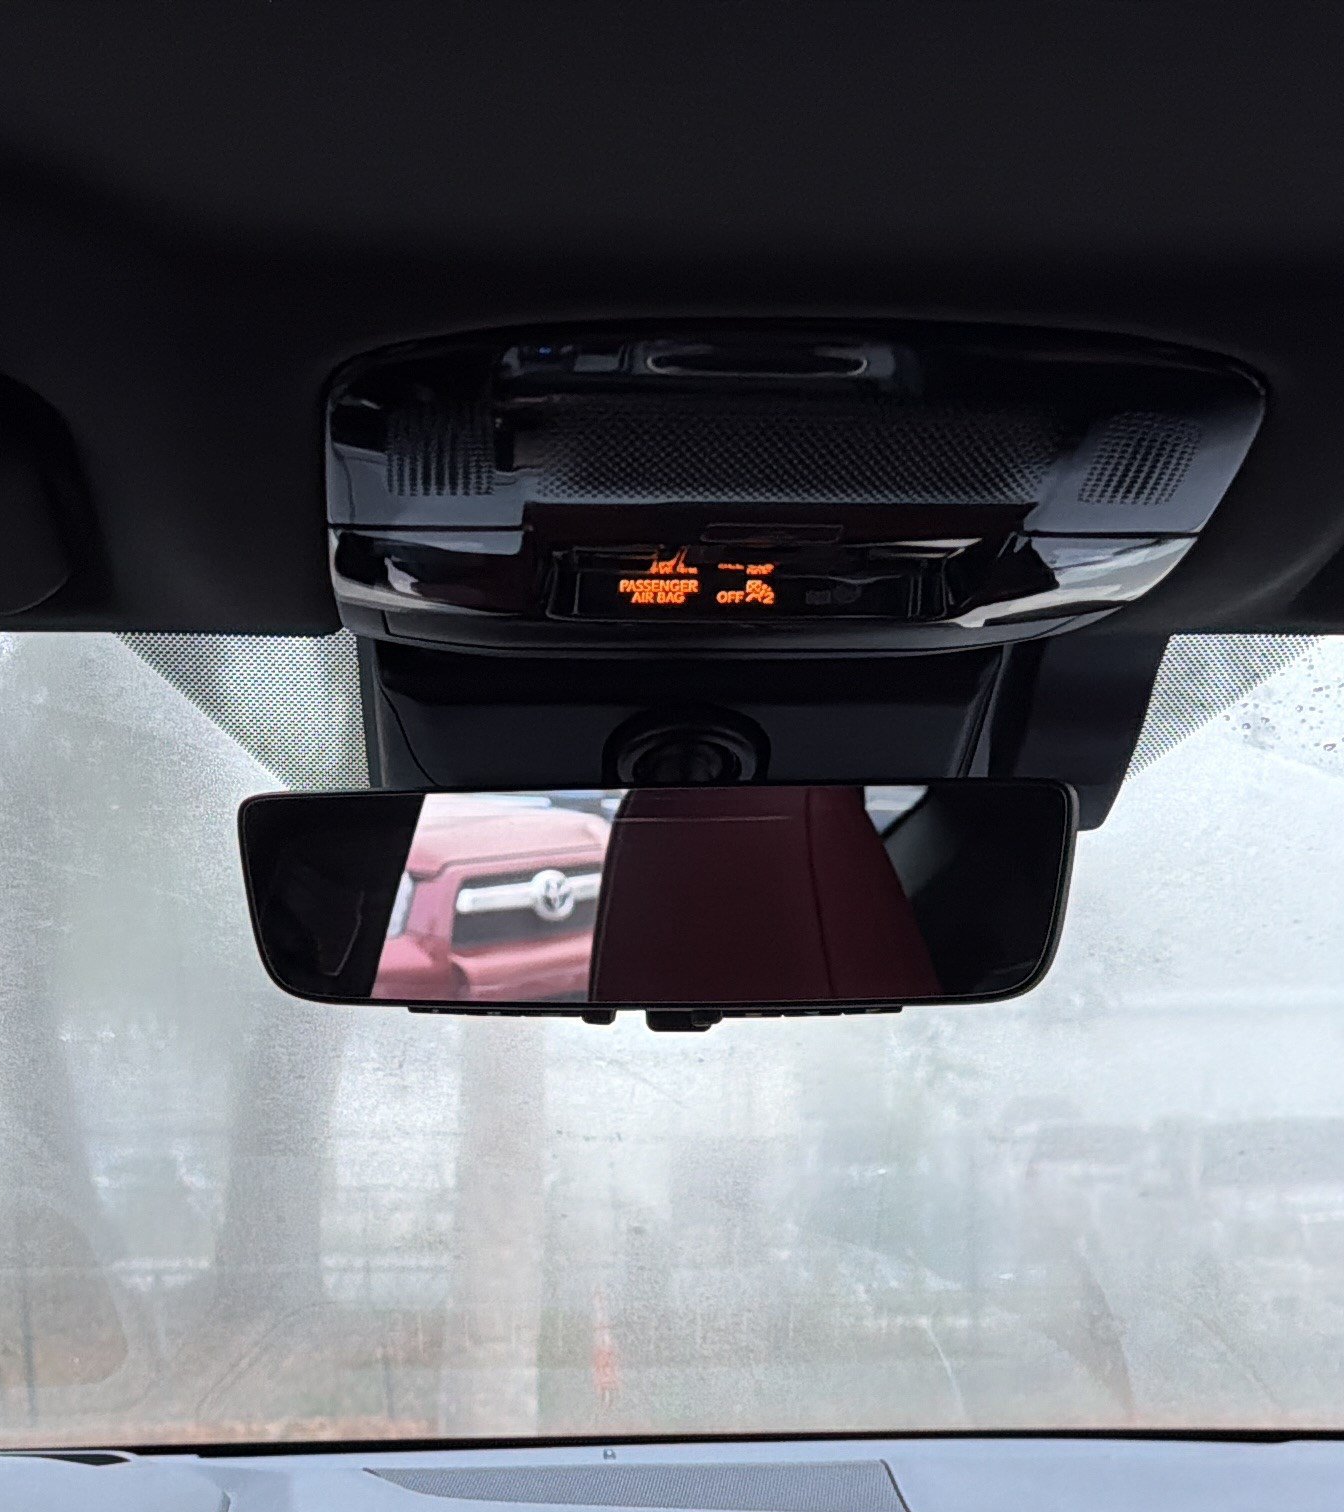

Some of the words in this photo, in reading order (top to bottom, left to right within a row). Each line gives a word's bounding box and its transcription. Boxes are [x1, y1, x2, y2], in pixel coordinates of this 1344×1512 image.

[619, 579, 699, 593] PASSENGER
[631, 592, 655, 604] AIR
[656, 592, 686, 604] BAG
[716, 591, 744, 604] OFF
